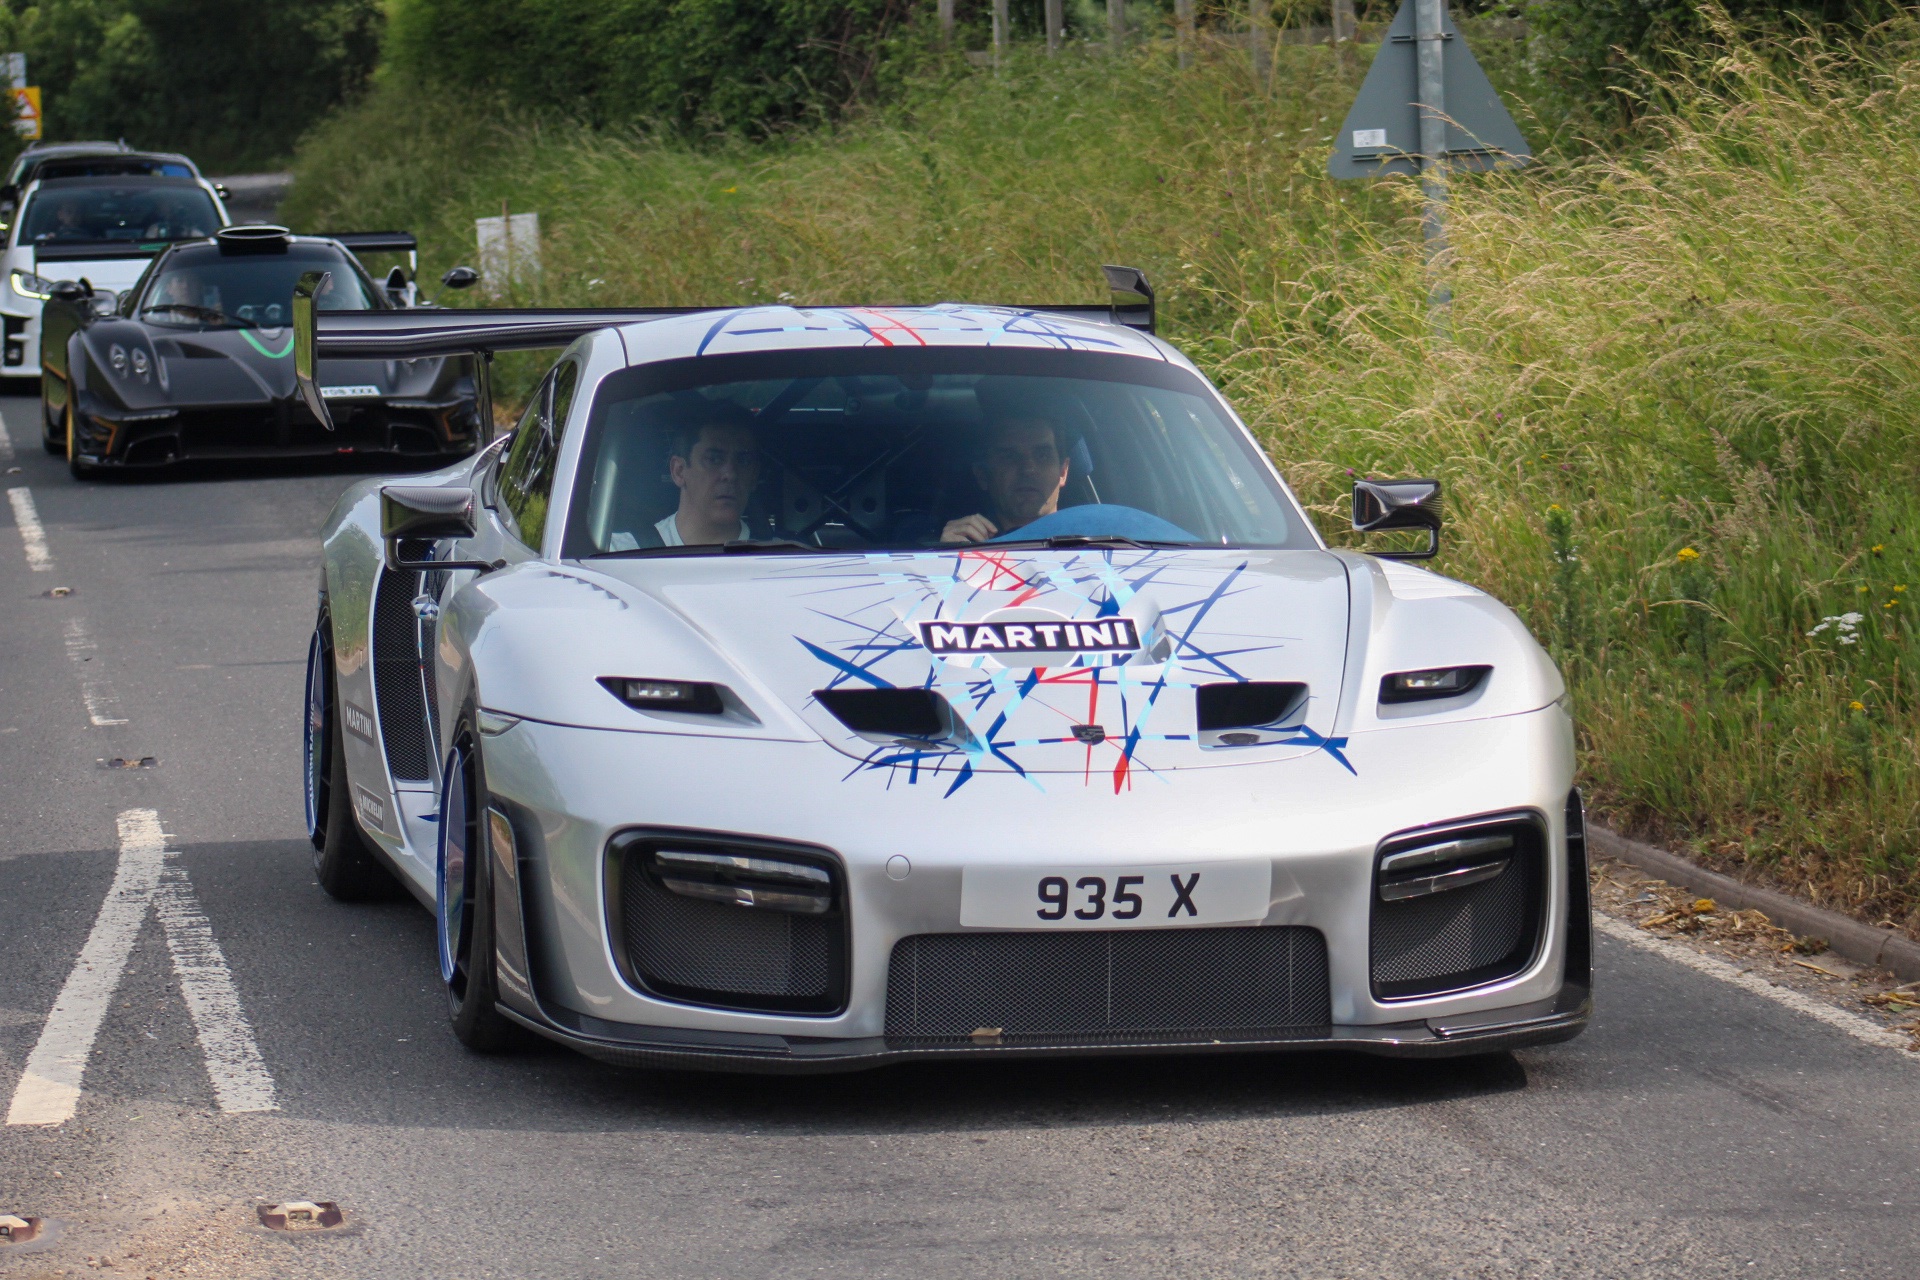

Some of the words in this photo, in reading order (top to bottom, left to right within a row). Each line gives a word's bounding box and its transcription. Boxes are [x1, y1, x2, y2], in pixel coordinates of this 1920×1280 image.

[930, 622, 1130, 649] MARTINI
[346, 706, 373, 739] MARTINI
[362, 794, 383, 821] MICHELIN
[1036, 875, 1145, 921] 935
[1167, 872, 1201, 918] X
